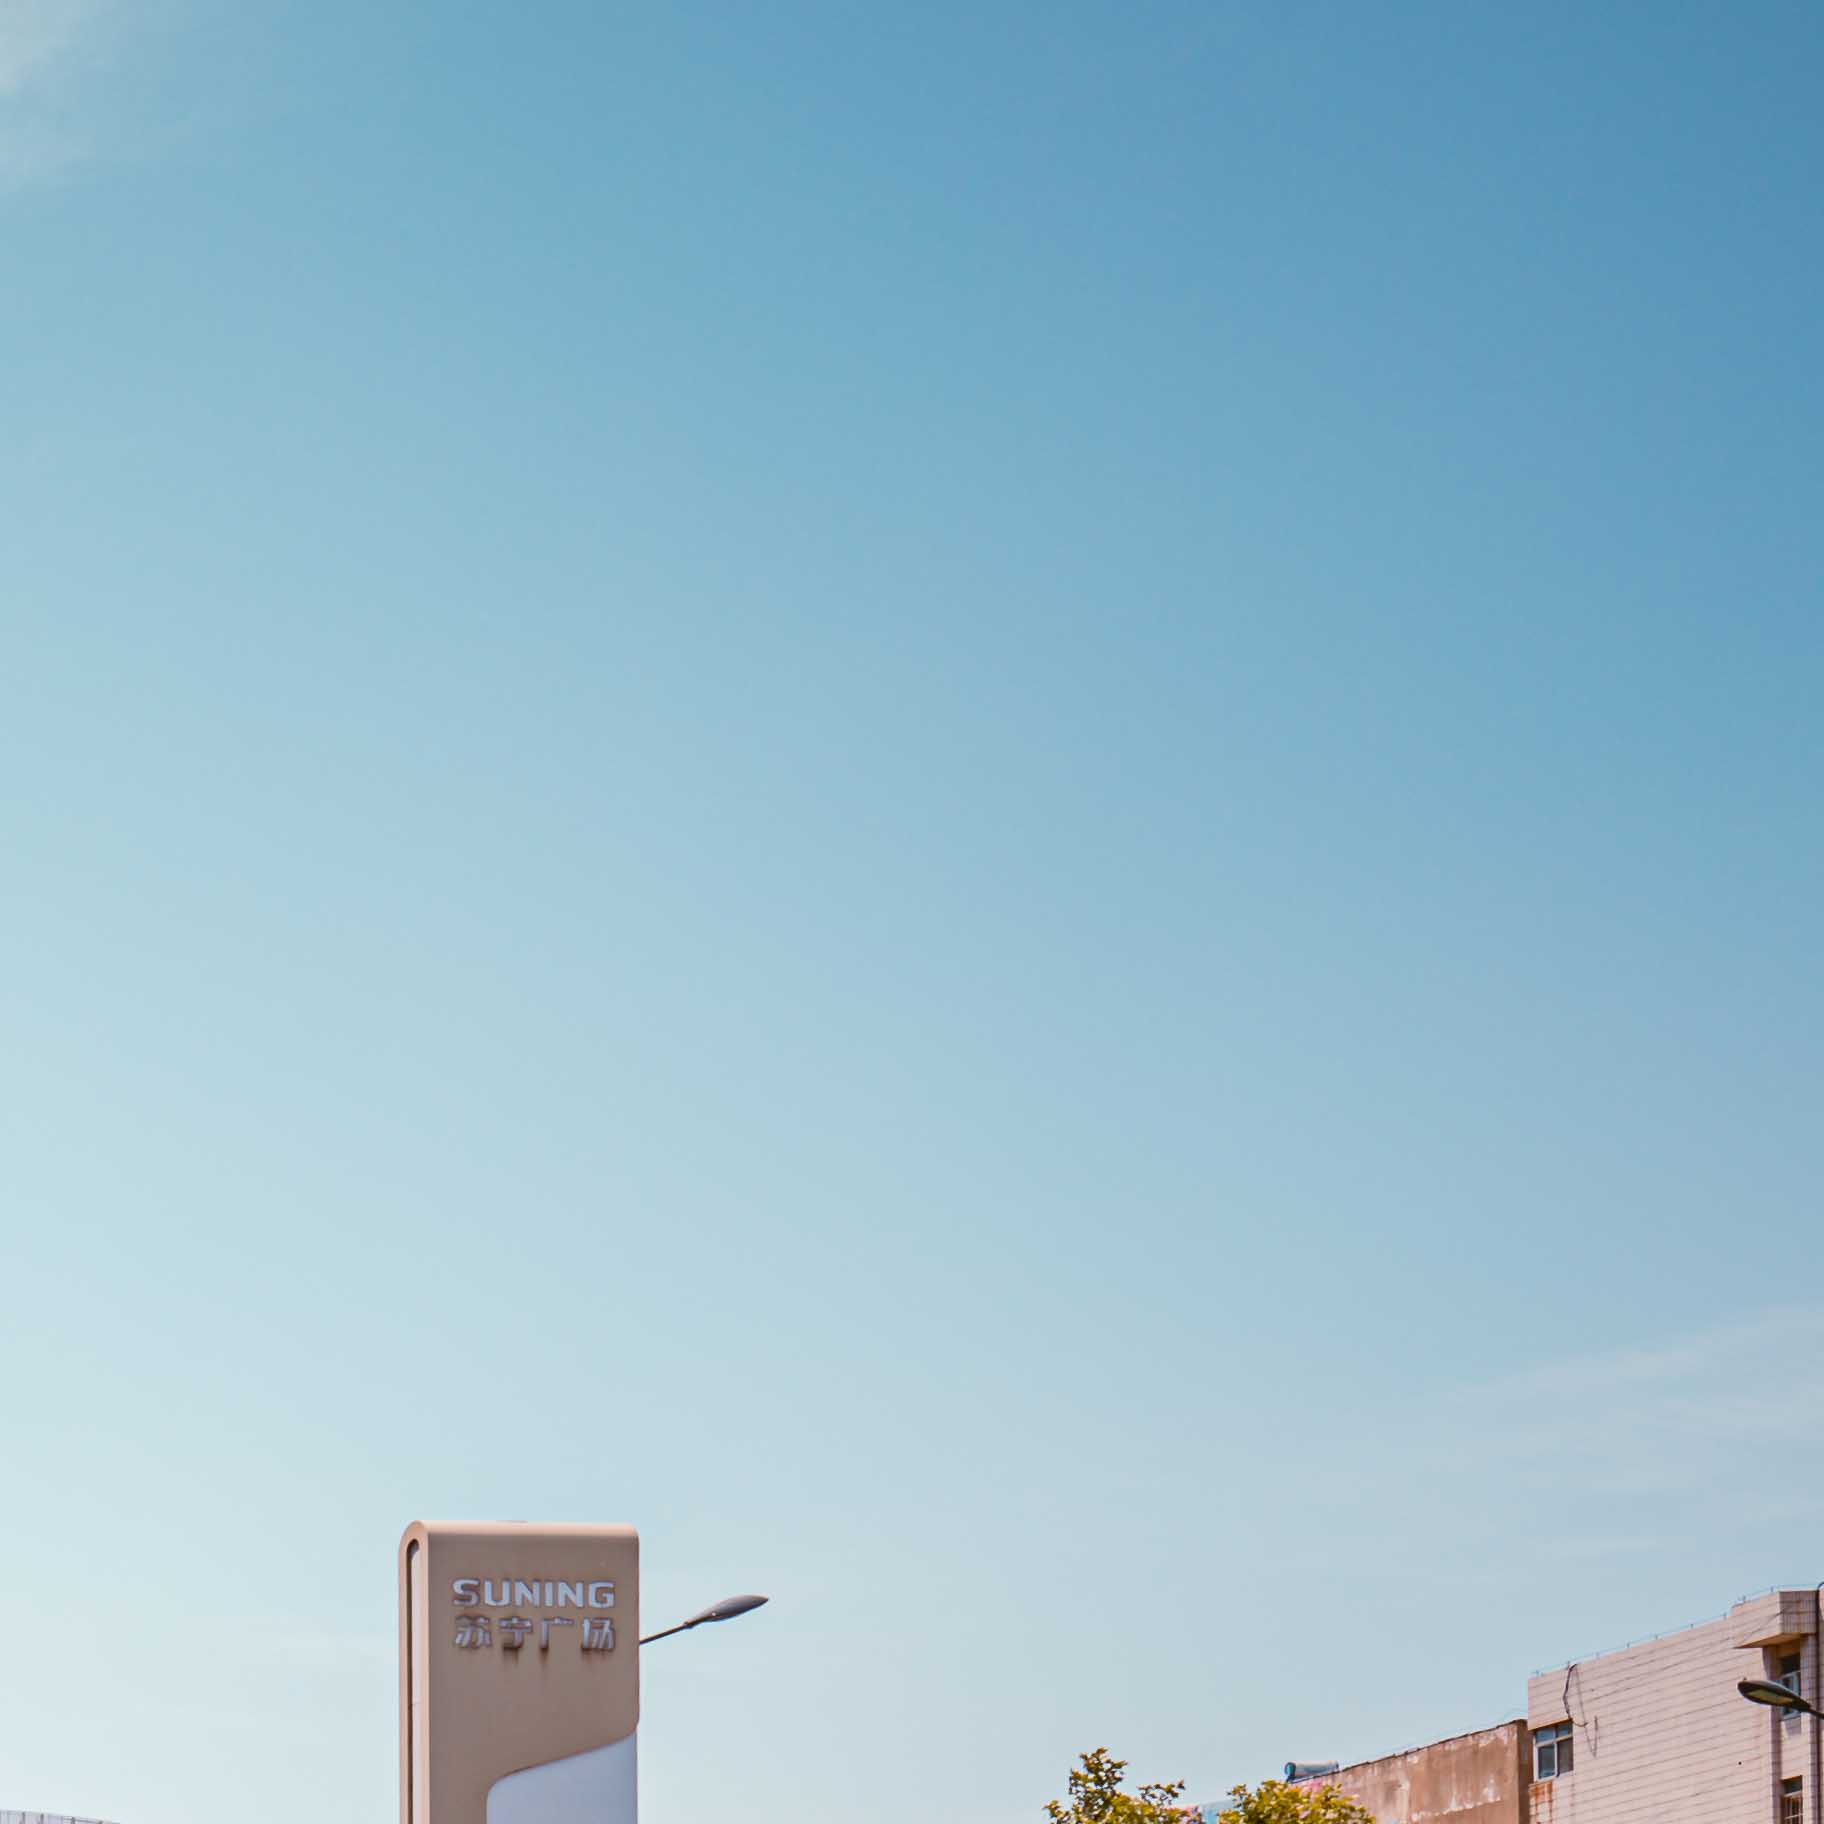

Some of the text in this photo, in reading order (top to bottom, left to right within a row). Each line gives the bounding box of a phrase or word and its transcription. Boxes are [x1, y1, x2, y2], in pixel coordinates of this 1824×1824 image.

[452, 1578, 616, 1609] SUNING
[455, 1615, 616, 1650] 苏宁广场
